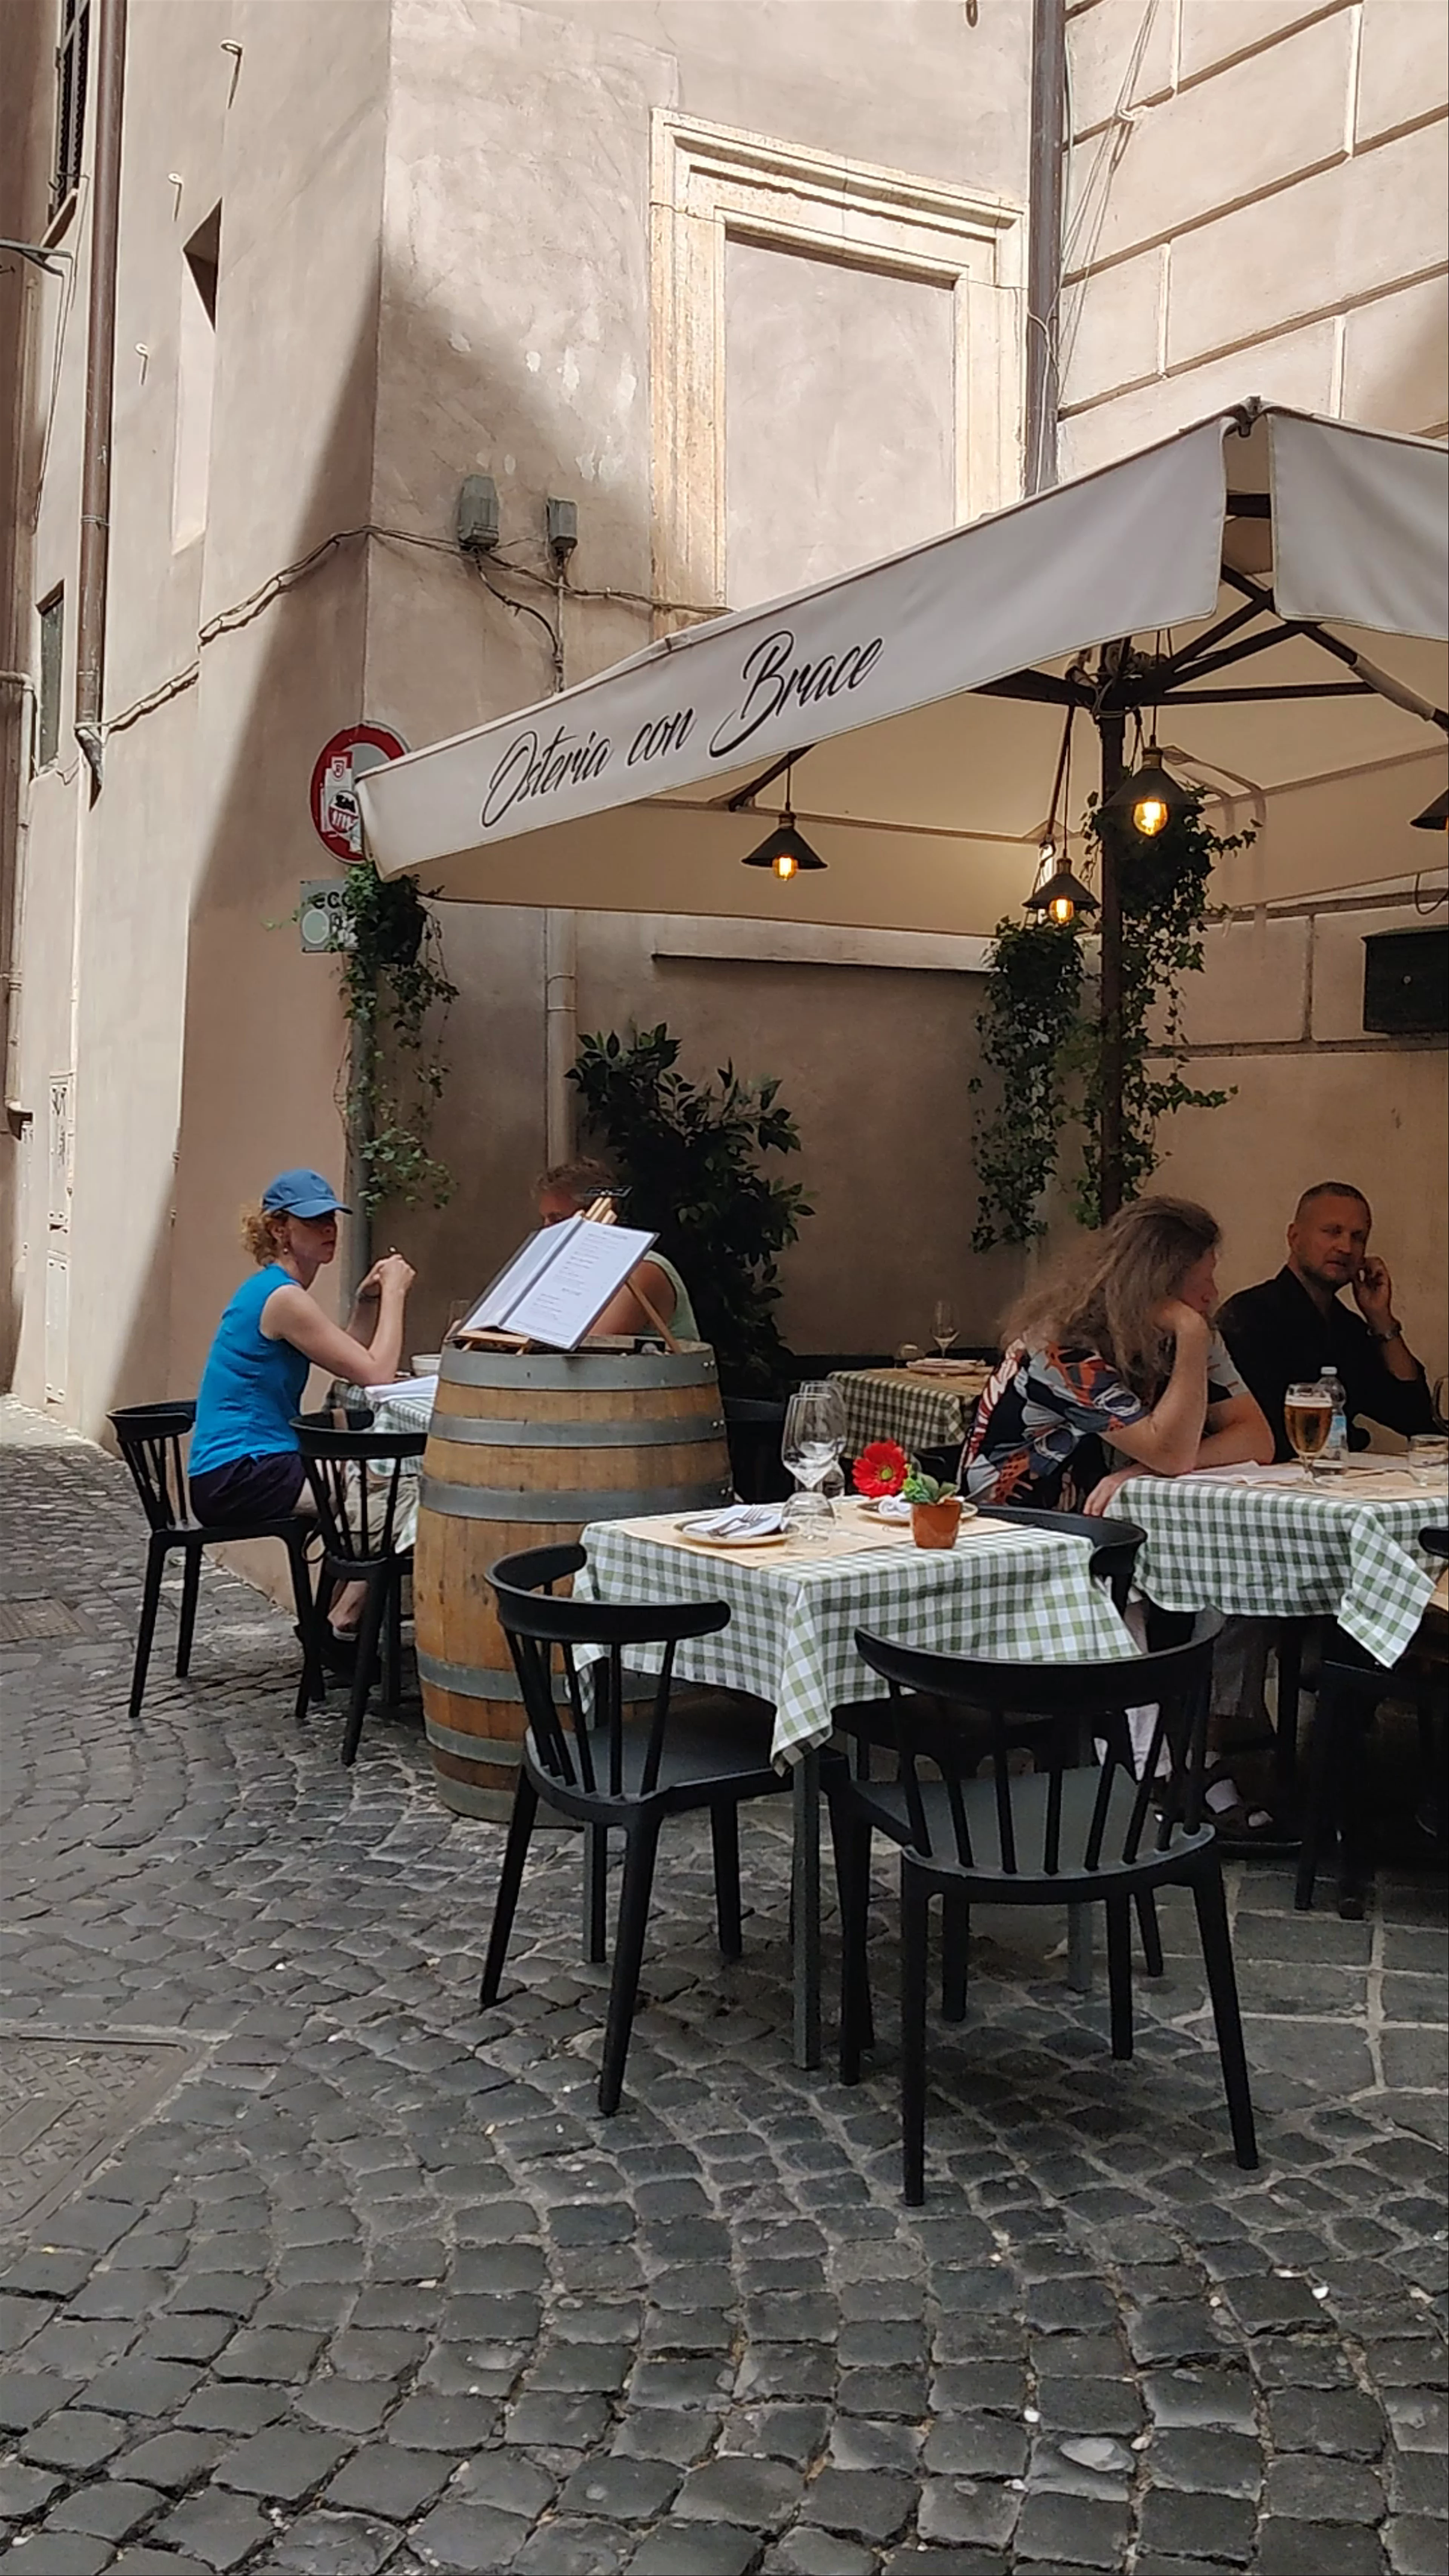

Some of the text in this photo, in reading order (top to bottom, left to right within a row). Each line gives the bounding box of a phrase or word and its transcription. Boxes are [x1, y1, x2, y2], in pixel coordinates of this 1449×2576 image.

[482, 631, 884, 827] Osteria con Brace
